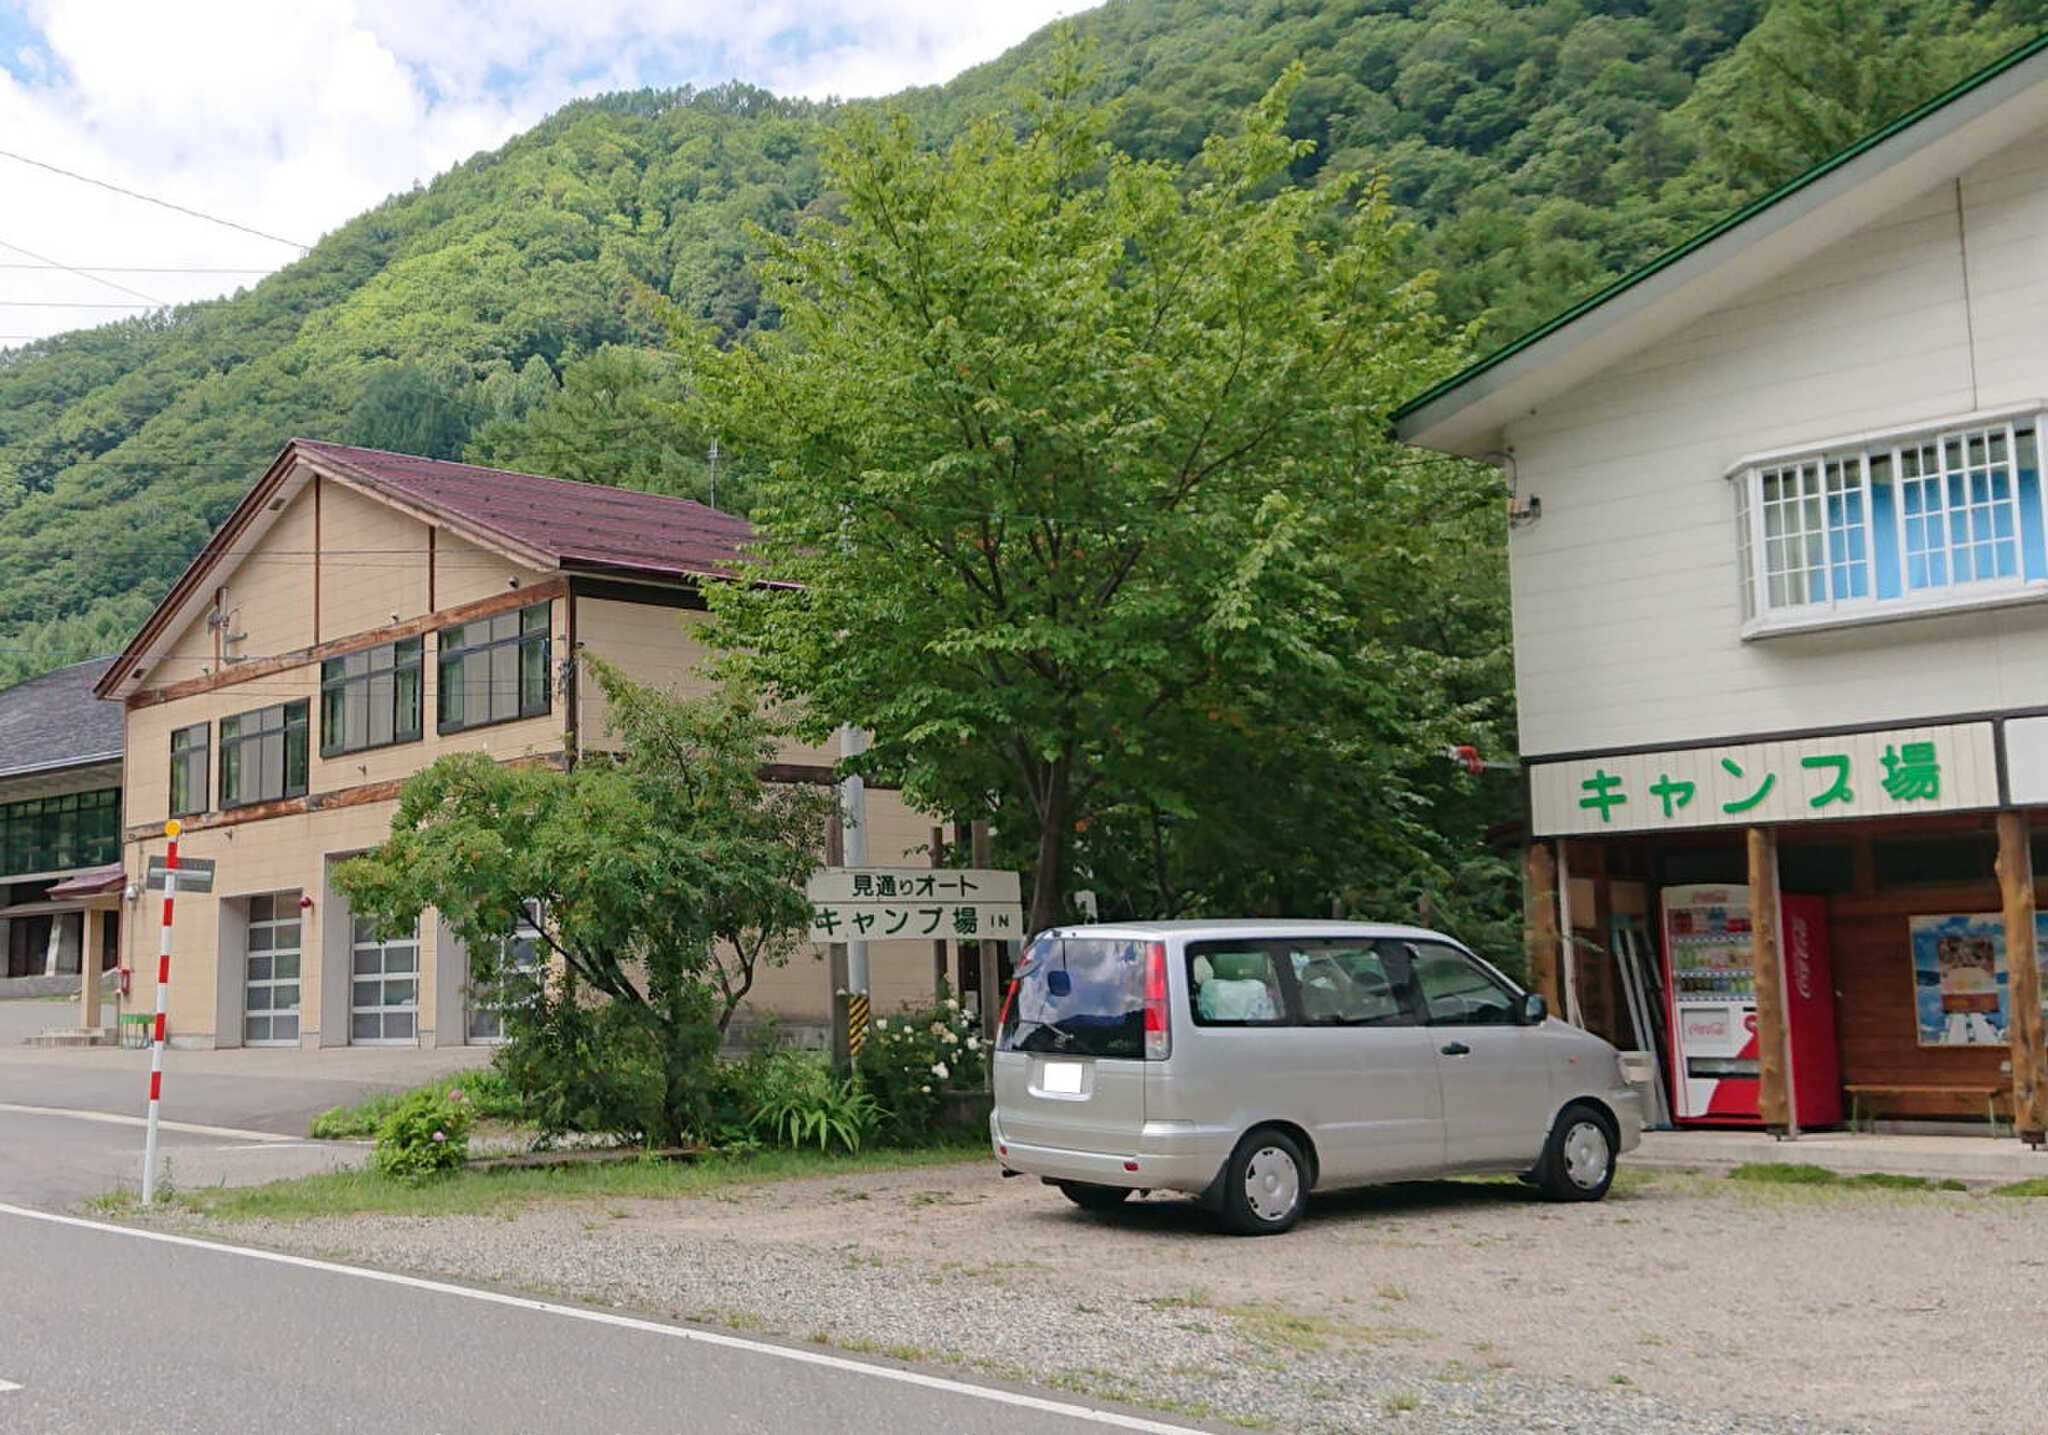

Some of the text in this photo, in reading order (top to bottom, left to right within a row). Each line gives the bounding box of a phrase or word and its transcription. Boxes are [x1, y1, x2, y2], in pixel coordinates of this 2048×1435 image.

[1578, 741, 1941, 822] キャンプ場
[852, 875, 978, 897] 見通りオート
[815, 907, 1010, 936] キャンプ場 IN
